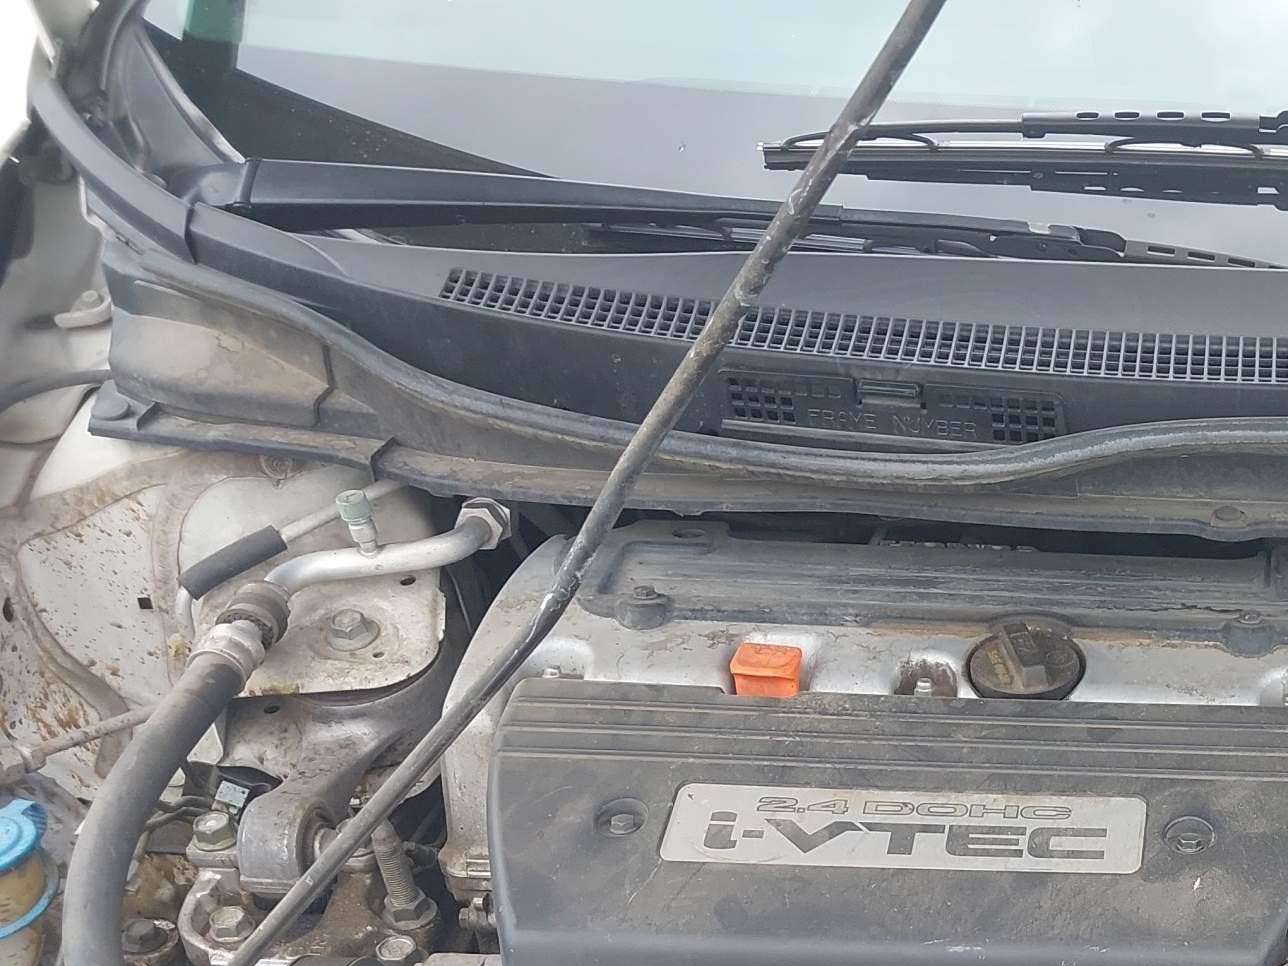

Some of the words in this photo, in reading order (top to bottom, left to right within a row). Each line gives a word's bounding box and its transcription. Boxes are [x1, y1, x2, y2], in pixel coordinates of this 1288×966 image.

[807, 408, 877, 429] FRAME
[893, 414, 977, 440] NUMBER
[756, 796, 849, 816] 2.4
[862, 800, 1072, 821] DOHC
[703, 810, 1108, 860] i-VTEC
